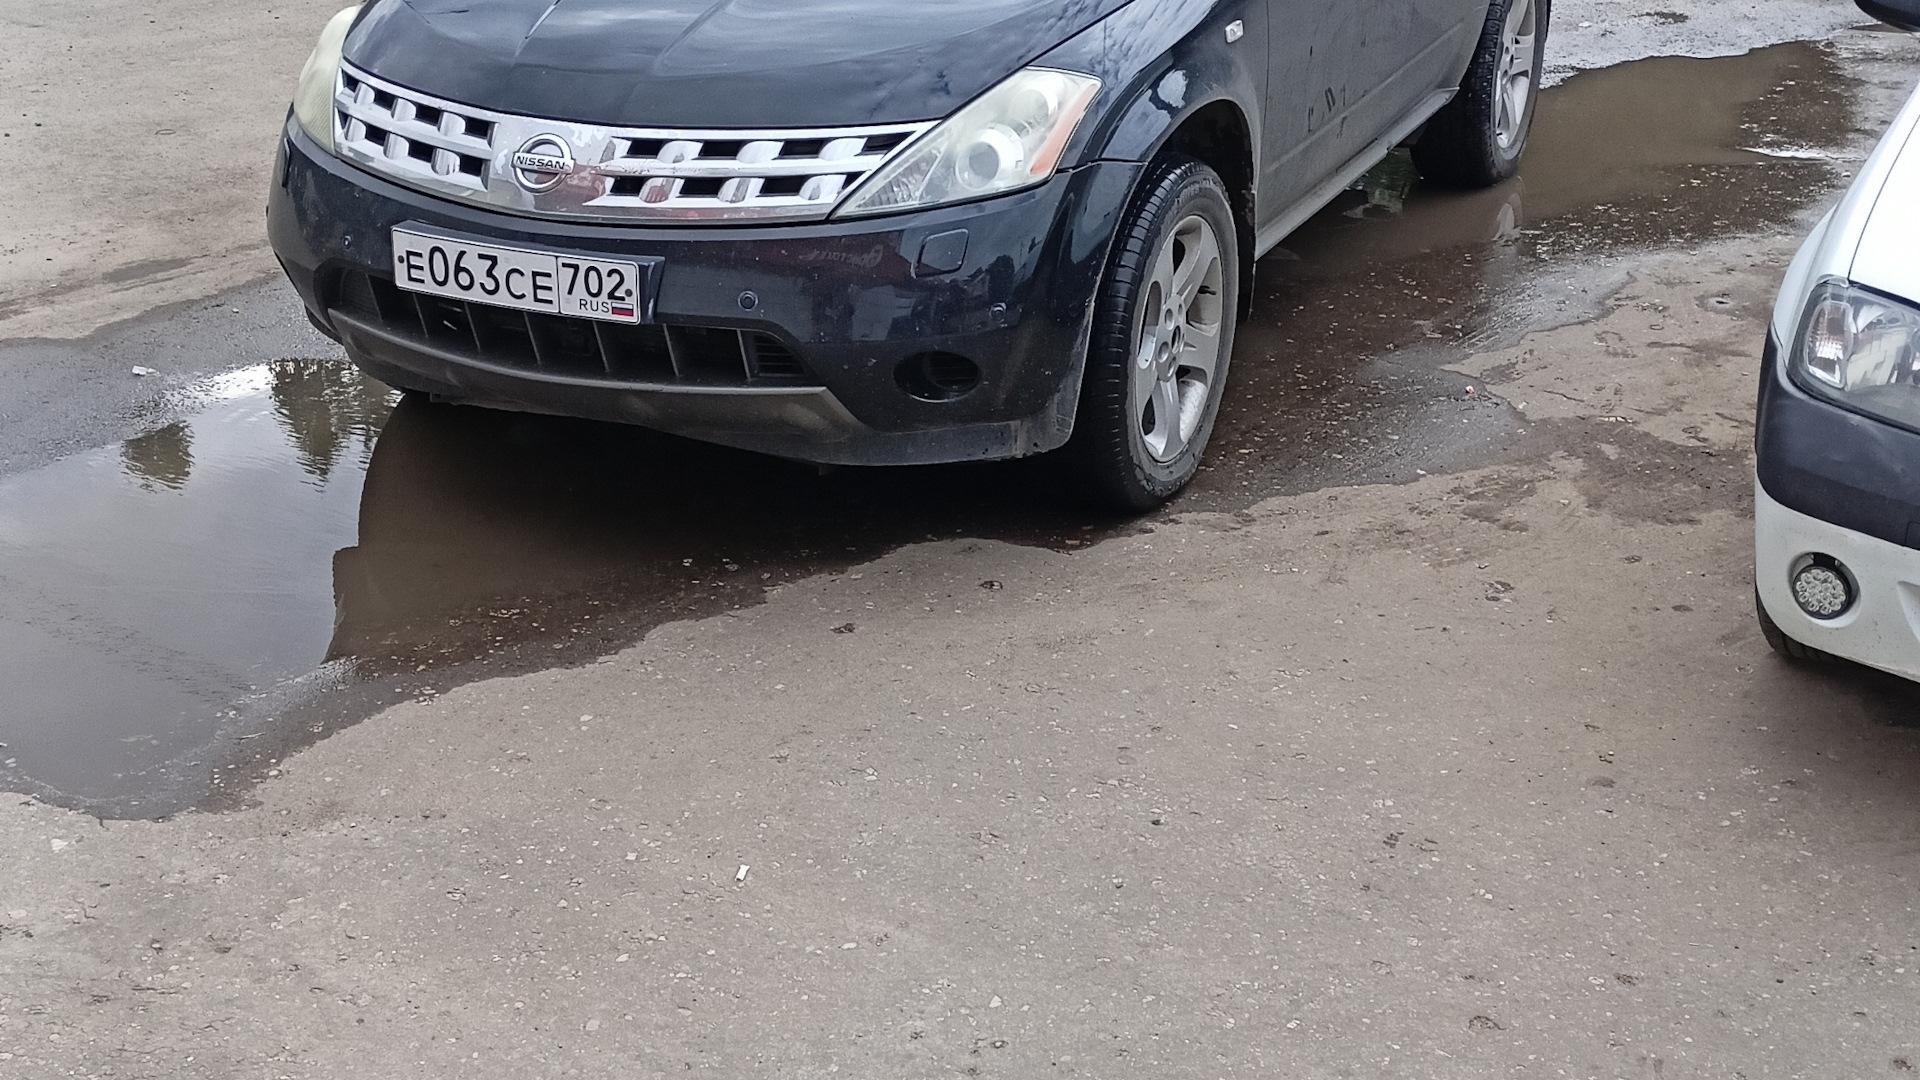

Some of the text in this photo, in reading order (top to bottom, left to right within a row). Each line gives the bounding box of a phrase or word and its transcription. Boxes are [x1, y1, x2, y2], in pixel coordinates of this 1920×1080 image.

[516, 155, 565, 170] NISSAN
[561, 262, 626, 302] 702
[579, 298, 610, 313] RUS
